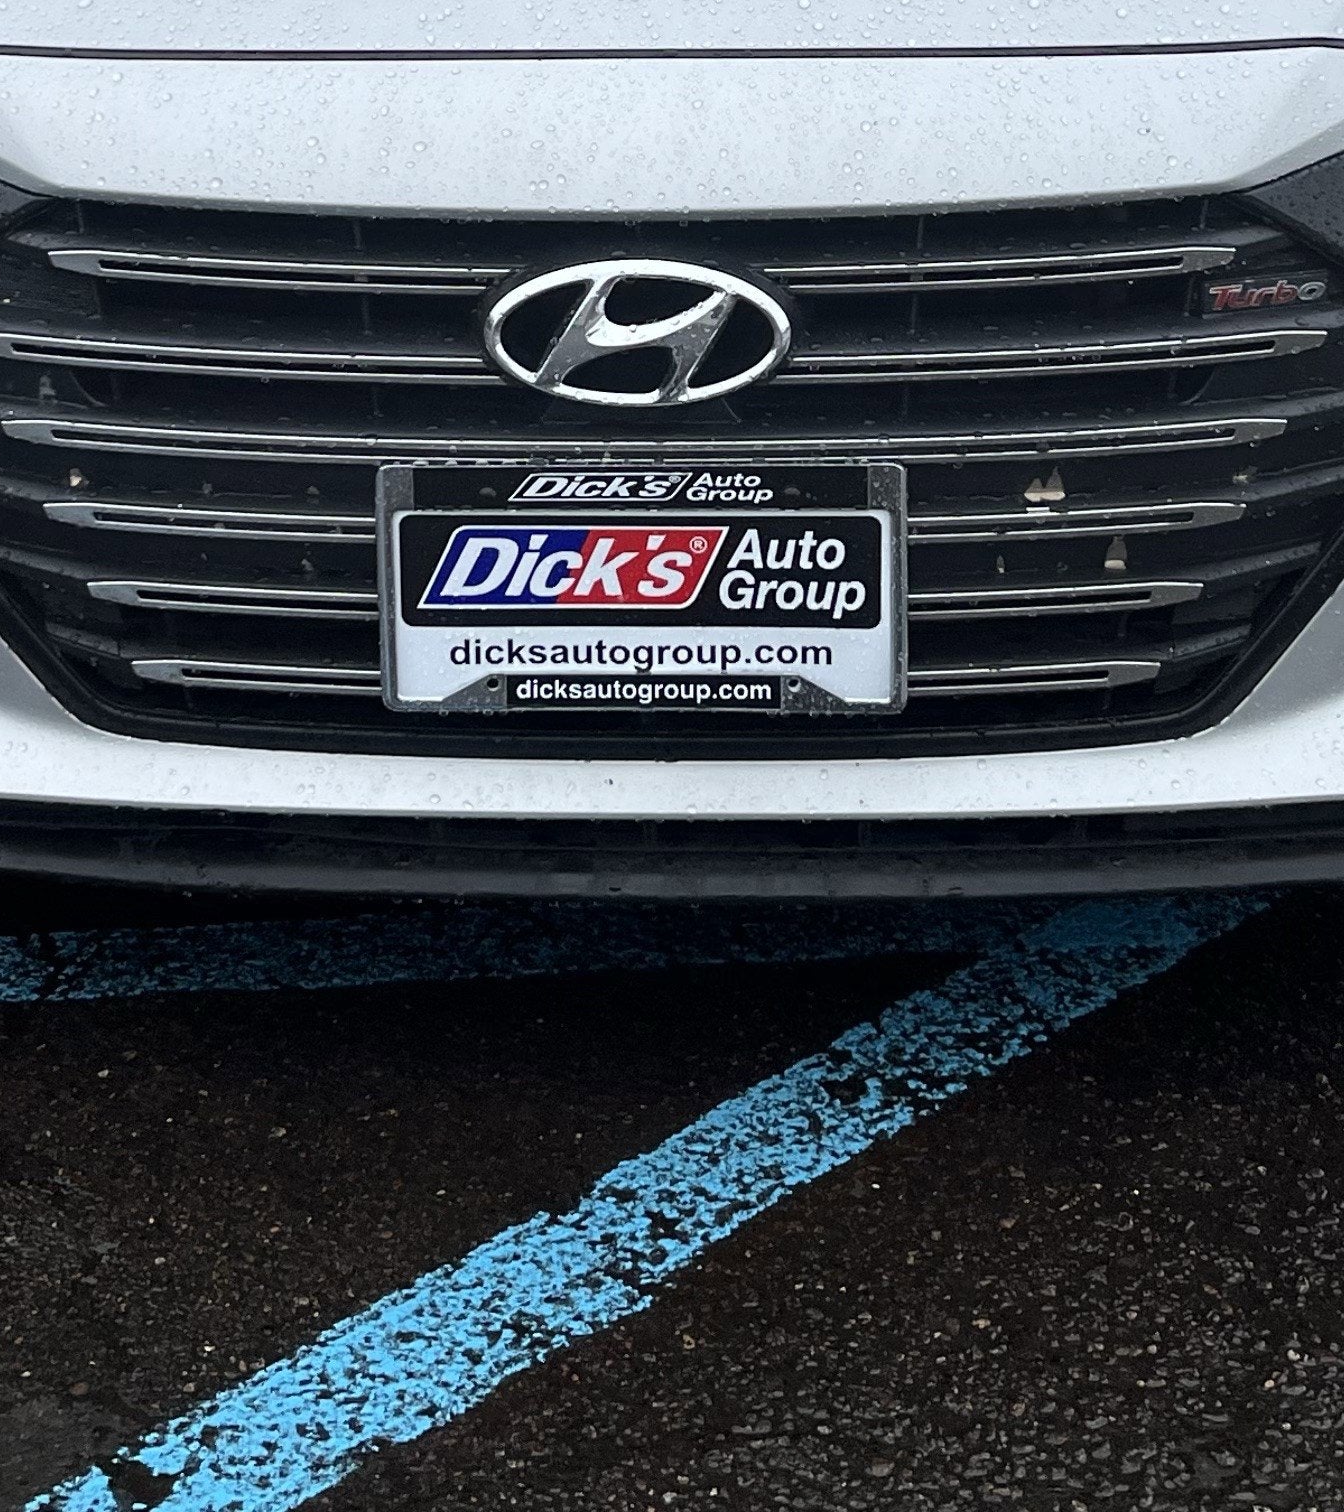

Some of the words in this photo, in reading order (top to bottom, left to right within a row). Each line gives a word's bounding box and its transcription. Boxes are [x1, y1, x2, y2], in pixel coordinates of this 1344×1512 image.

[1209, 280, 1326, 311] Turbo
[522, 475, 673, 498] Dick's
[692, 472, 761, 487] Auto
[686, 487, 773, 504] Group
[726, 528, 846, 570] Auto
[440, 533, 693, 598] Dick's
[719, 569, 866, 619] Group
[449, 638, 834, 670] dicksautogroup.com
[515, 680, 772, 705] dicksautogroup.com
